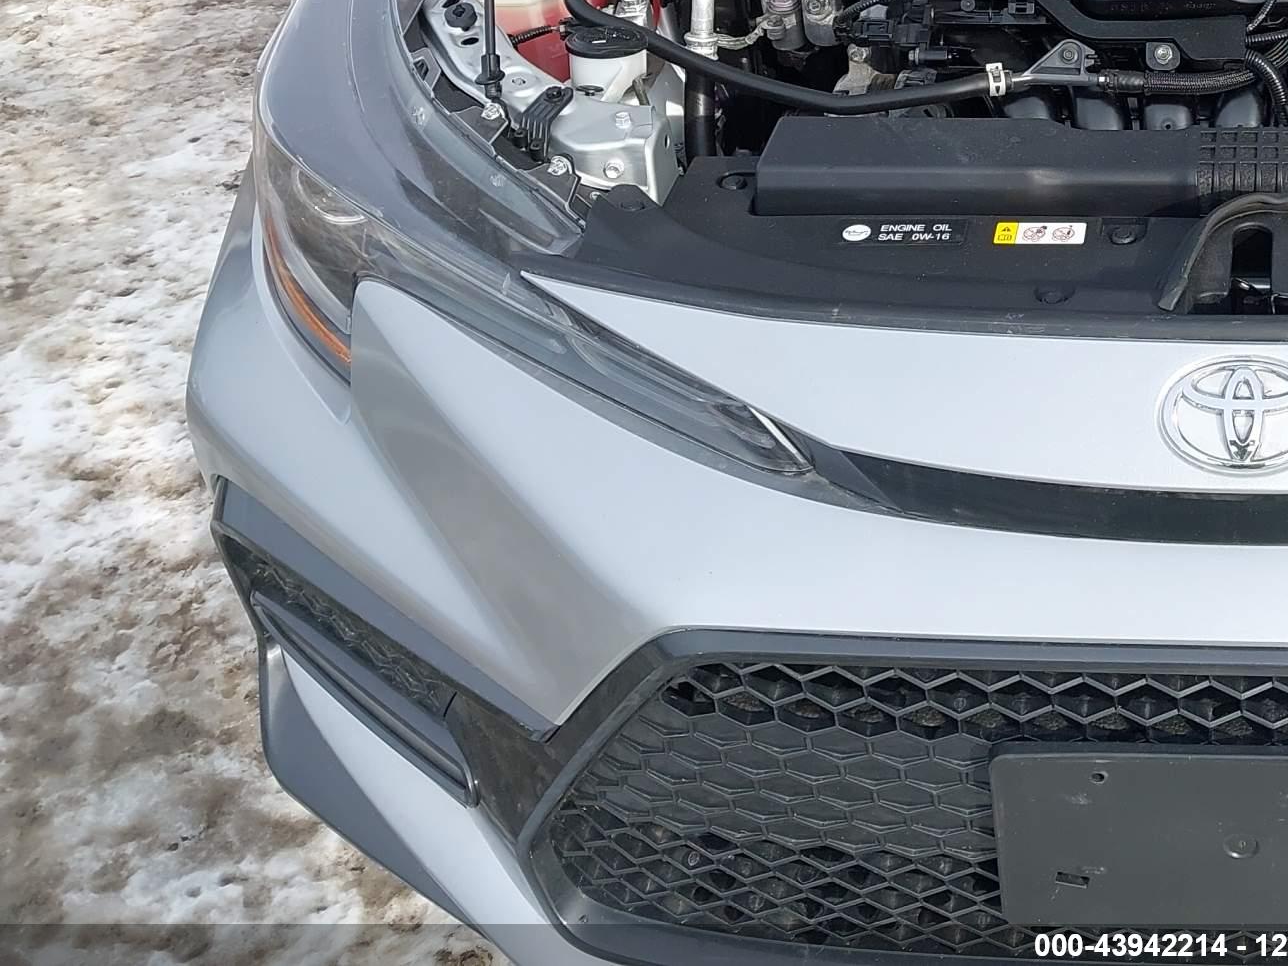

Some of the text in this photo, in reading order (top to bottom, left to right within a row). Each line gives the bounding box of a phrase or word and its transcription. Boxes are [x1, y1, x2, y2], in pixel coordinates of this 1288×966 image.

[880, 224, 953, 232] ENGINE OIL
[877, 233, 951, 241] SAE 0W-16
